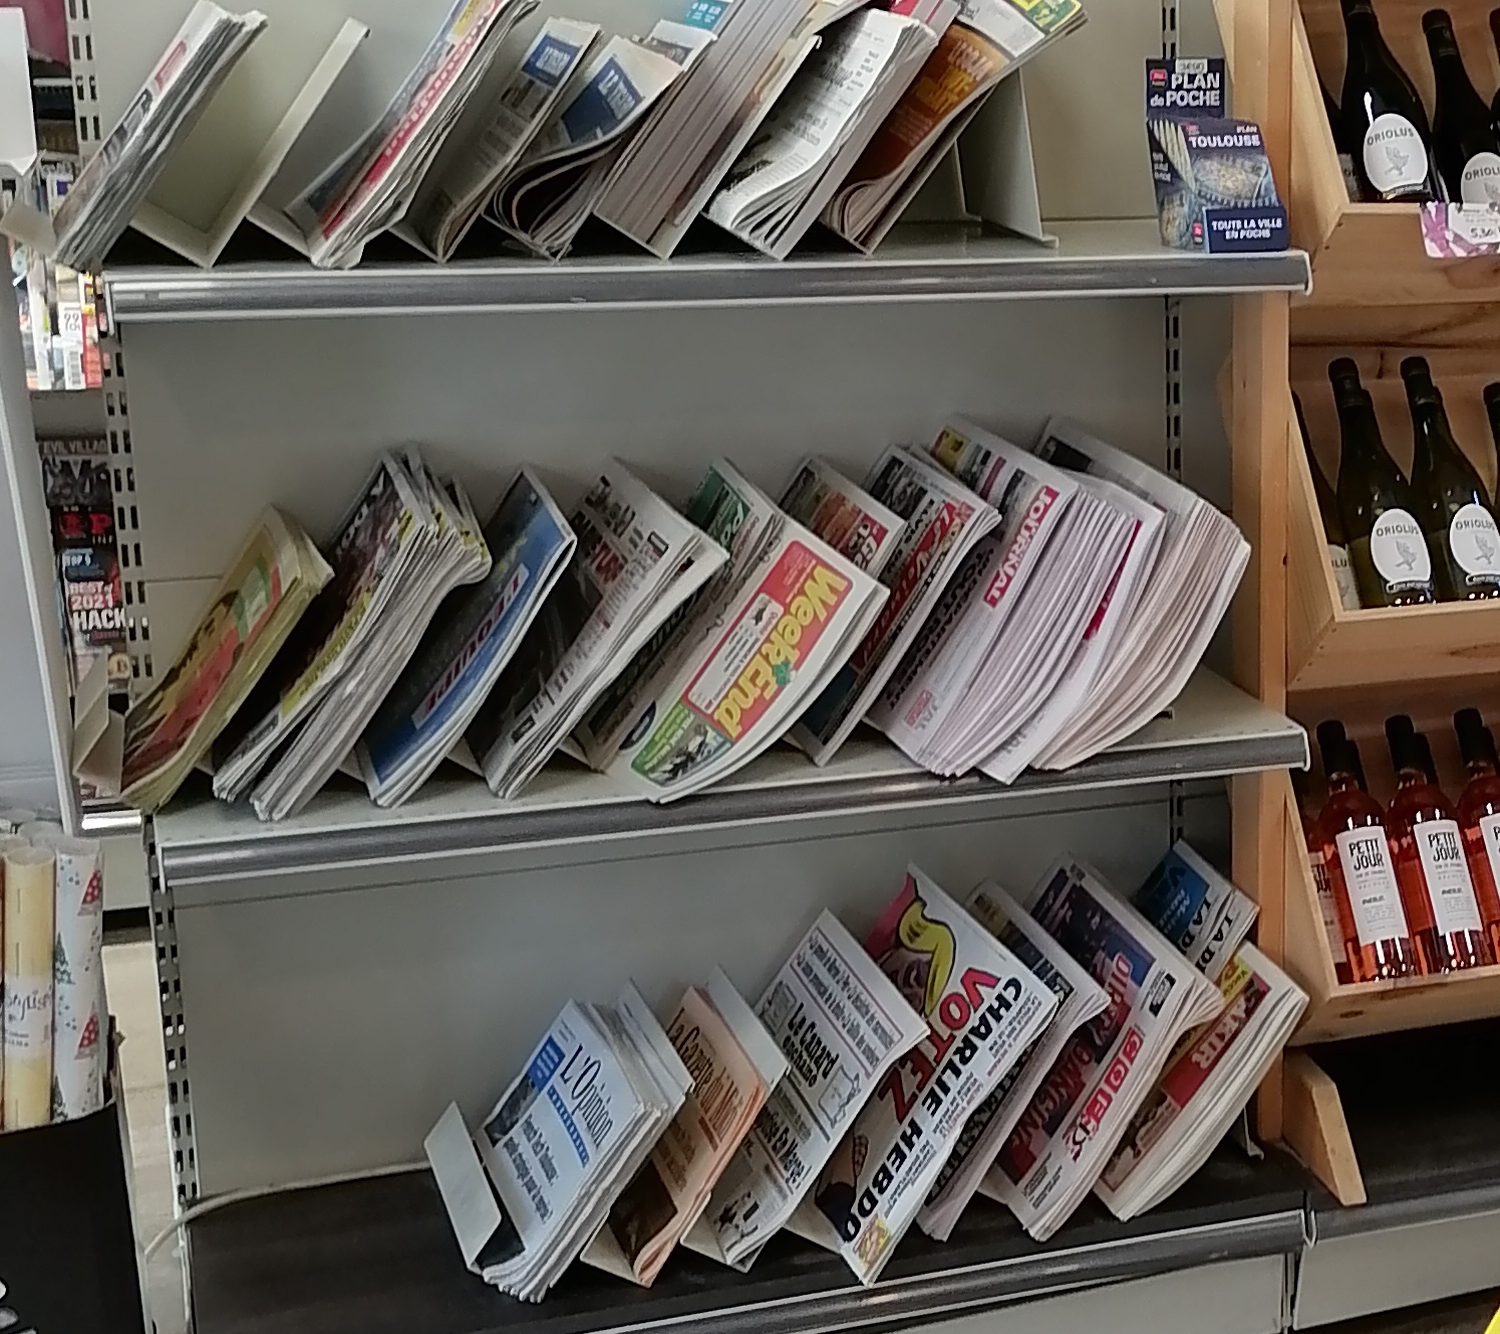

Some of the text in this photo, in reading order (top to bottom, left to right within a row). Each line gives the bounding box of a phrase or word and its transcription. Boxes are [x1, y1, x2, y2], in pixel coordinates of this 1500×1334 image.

[1171, 72, 1220, 90] PLAN
[1166, 90, 1220, 107] POCHE
[1189, 134, 1261, 149] TOULOUSE
[1367, 127, 1416, 146] ORIOLUS
[1375, 523, 1421, 539] ORIOLUS
[1454, 517, 1497, 535] ORIOLUS
[987, 487, 1056, 607] JOURNAL
[70, 593, 114, 610] 2021
[1348, 838, 1381, 858] PETIT
[1427, 831, 1456, 850] PETIT
[1353, 852, 1384, 871] JOUR
[1431, 844, 1461, 862] JOUR
[877, 966, 1002, 1128] VOTEZ
[560, 1043, 614, 1150] L'Opinion
[842, 976, 1025, 1245] CHARLIE HEBDO
